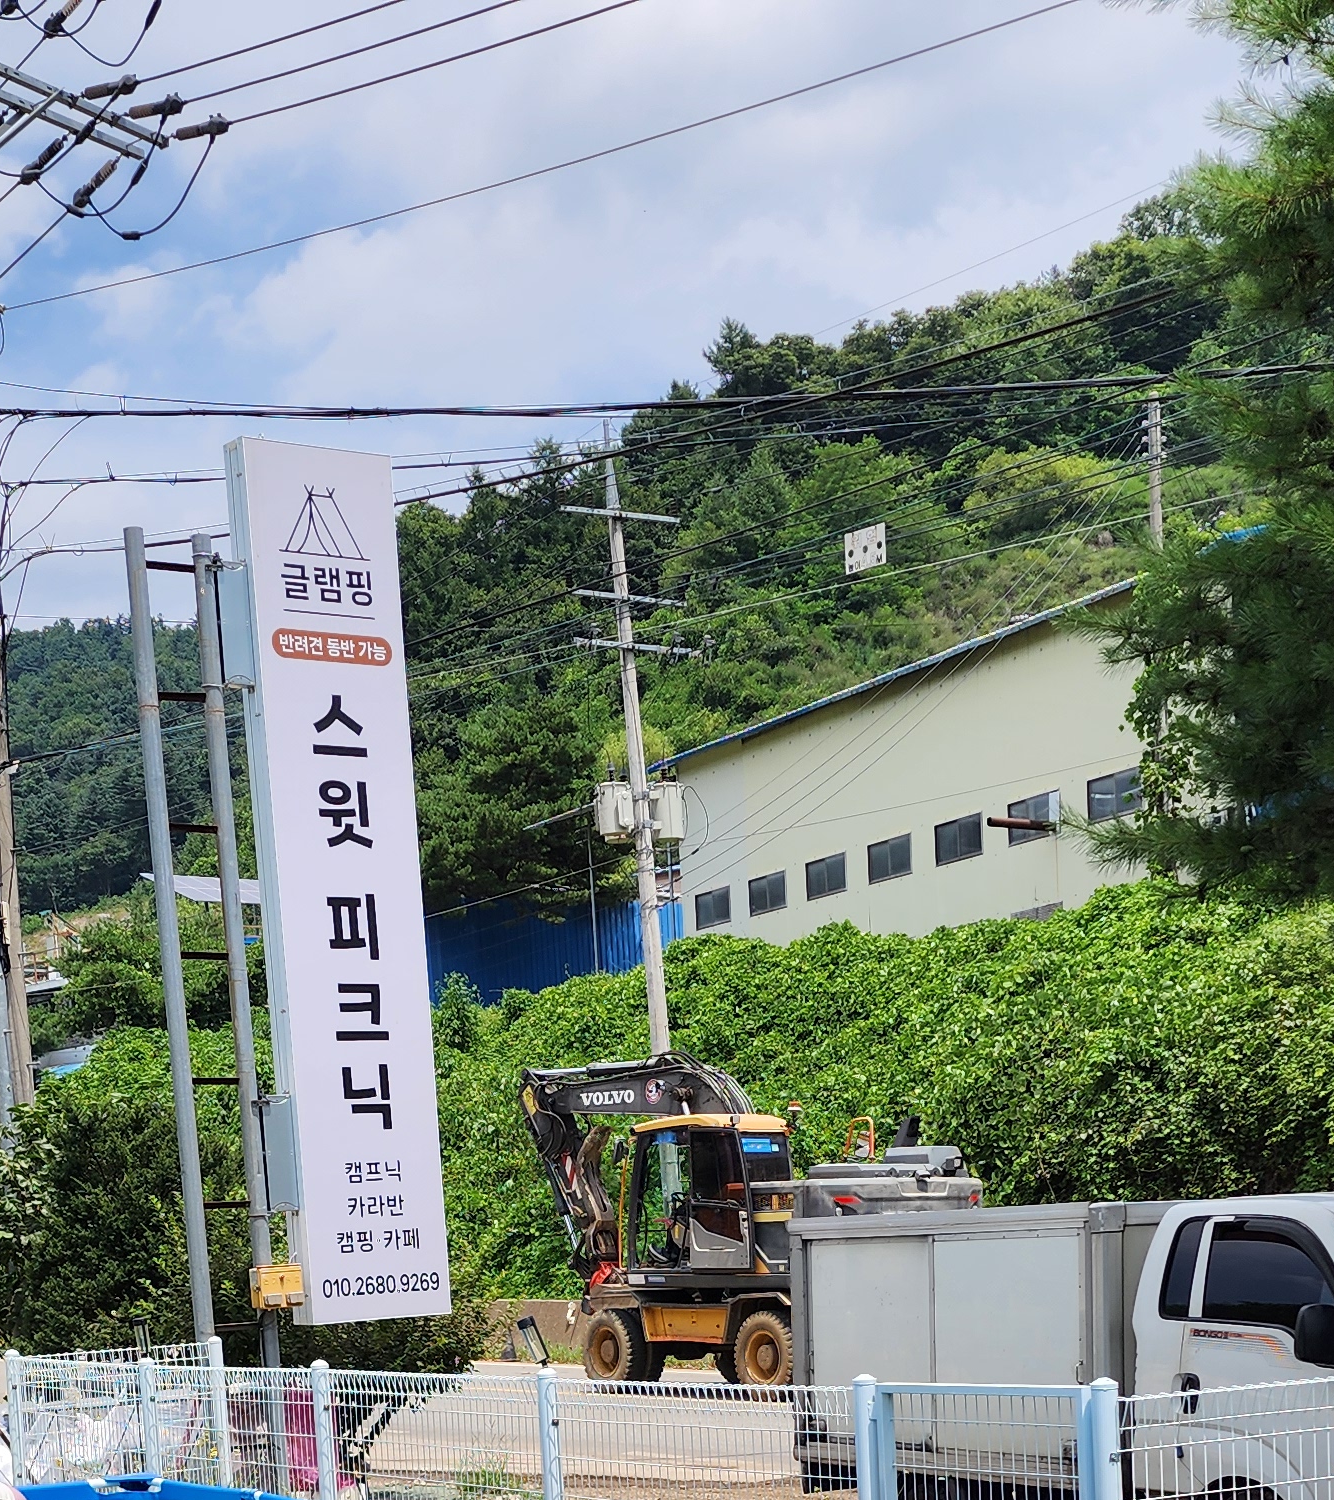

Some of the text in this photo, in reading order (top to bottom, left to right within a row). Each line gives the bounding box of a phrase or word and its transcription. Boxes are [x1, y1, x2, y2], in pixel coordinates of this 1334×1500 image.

[280, 562, 373, 607] 글램핑
[278, 633, 387, 661] 반려견 동반 가능
[312, 694, 393, 1130] 스윗 피크닉
[580, 1089, 635, 1106] VOLVO
[344, 1160, 402, 1184] 캠프닉
[347, 1194, 405, 1218] 카라반
[322, 1272, 440, 1298] 010.2680.9269
